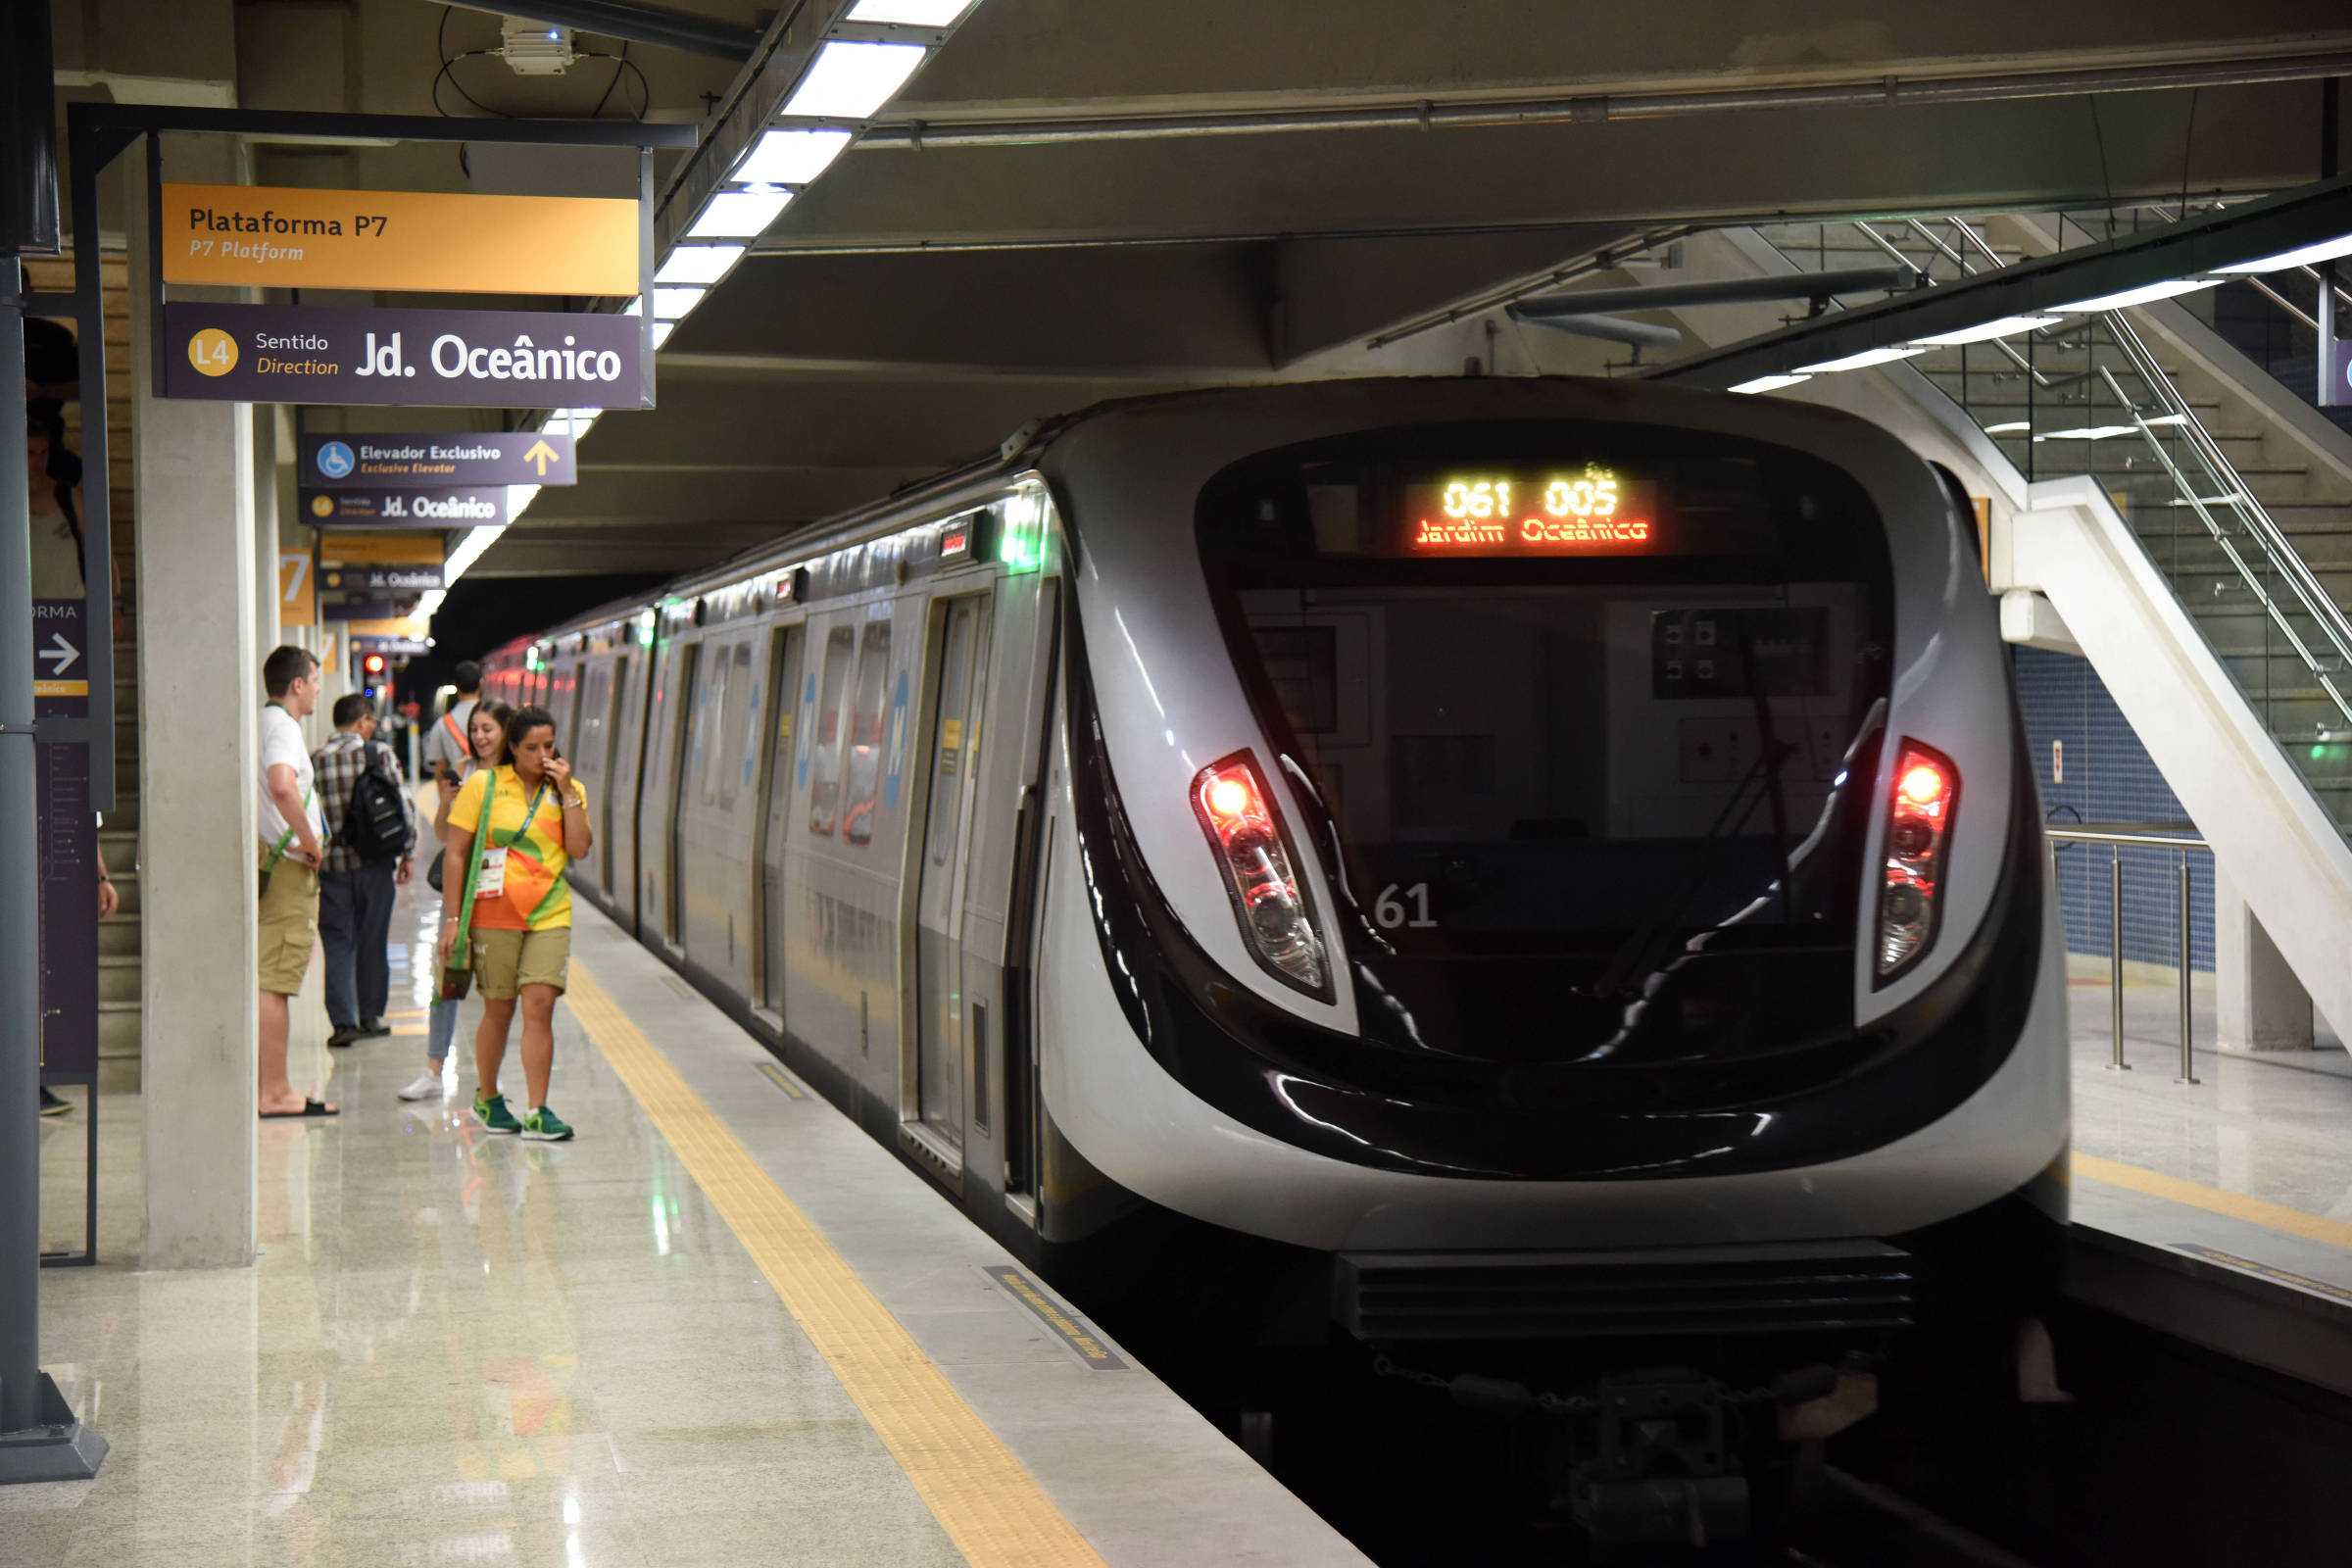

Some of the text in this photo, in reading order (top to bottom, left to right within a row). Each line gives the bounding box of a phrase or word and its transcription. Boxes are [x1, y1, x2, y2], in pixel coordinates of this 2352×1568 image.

[189, 208, 388, 237] Plataforma P7
[189, 239, 305, 264] P7 Platform
[196, 338, 230, 366] L4
[255, 332, 329, 351] Sentido
[256, 357, 339, 375] Direction
[354, 331, 622, 381] Jd. Oceânico
[360, 445, 502, 461] Elevador Exclusivo
[380, 495, 409, 518] Jd.
[412, 496, 497, 519] Oceânico
[1443, 480, 1618, 517] 061 005
[1417, 517, 1649, 543] Jardim Oceânico
[1374, 882, 1439, 929] 61
